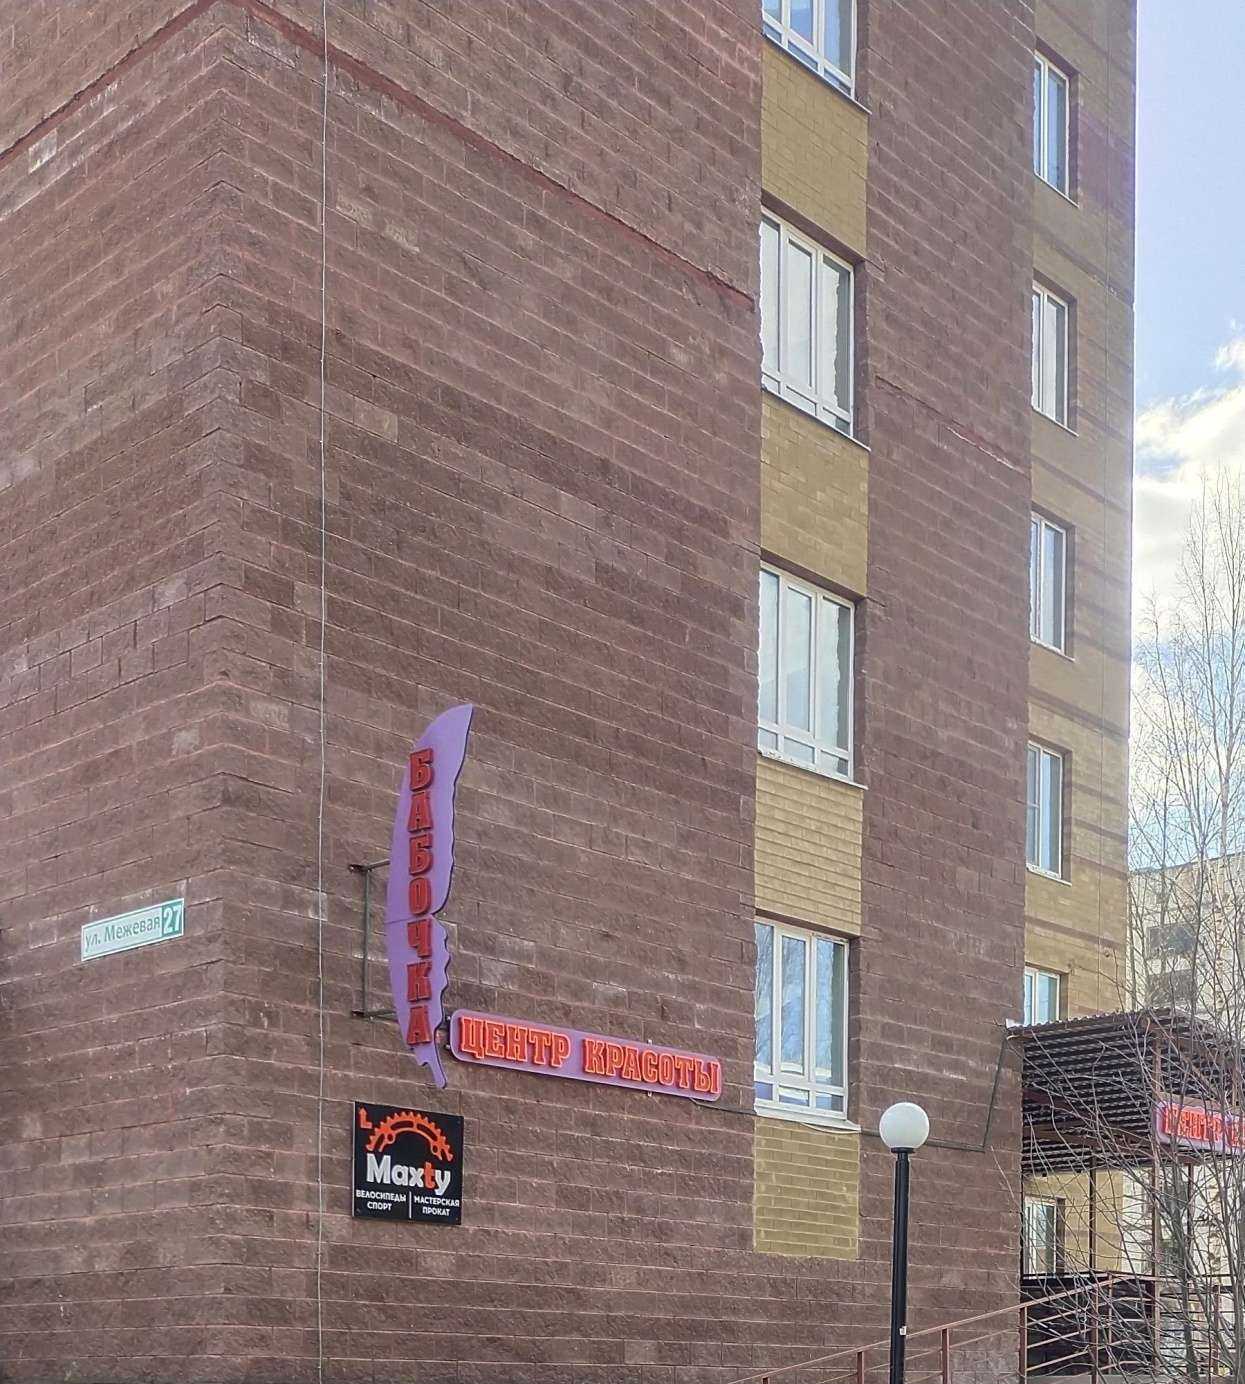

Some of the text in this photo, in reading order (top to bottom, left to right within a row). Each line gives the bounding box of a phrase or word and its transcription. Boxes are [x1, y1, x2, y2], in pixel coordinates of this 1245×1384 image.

[407, 748, 434, 1045] БАБОЧКА
[85, 905, 182, 952] ул. Межевая 27
[460, 1016, 721, 1094] ЦЕНТР КРАСОТЫ
[366, 1153, 451, 1195] Maxty
[356, 1190, 406, 1202] ВЕЛОСИПЕДЫ
[367, 1202, 392, 1211] СПОРТ
[414, 1195, 460, 1207] МАСТЕРСКАЯ
[422, 1207, 450, 1216] ПРОКАТ
